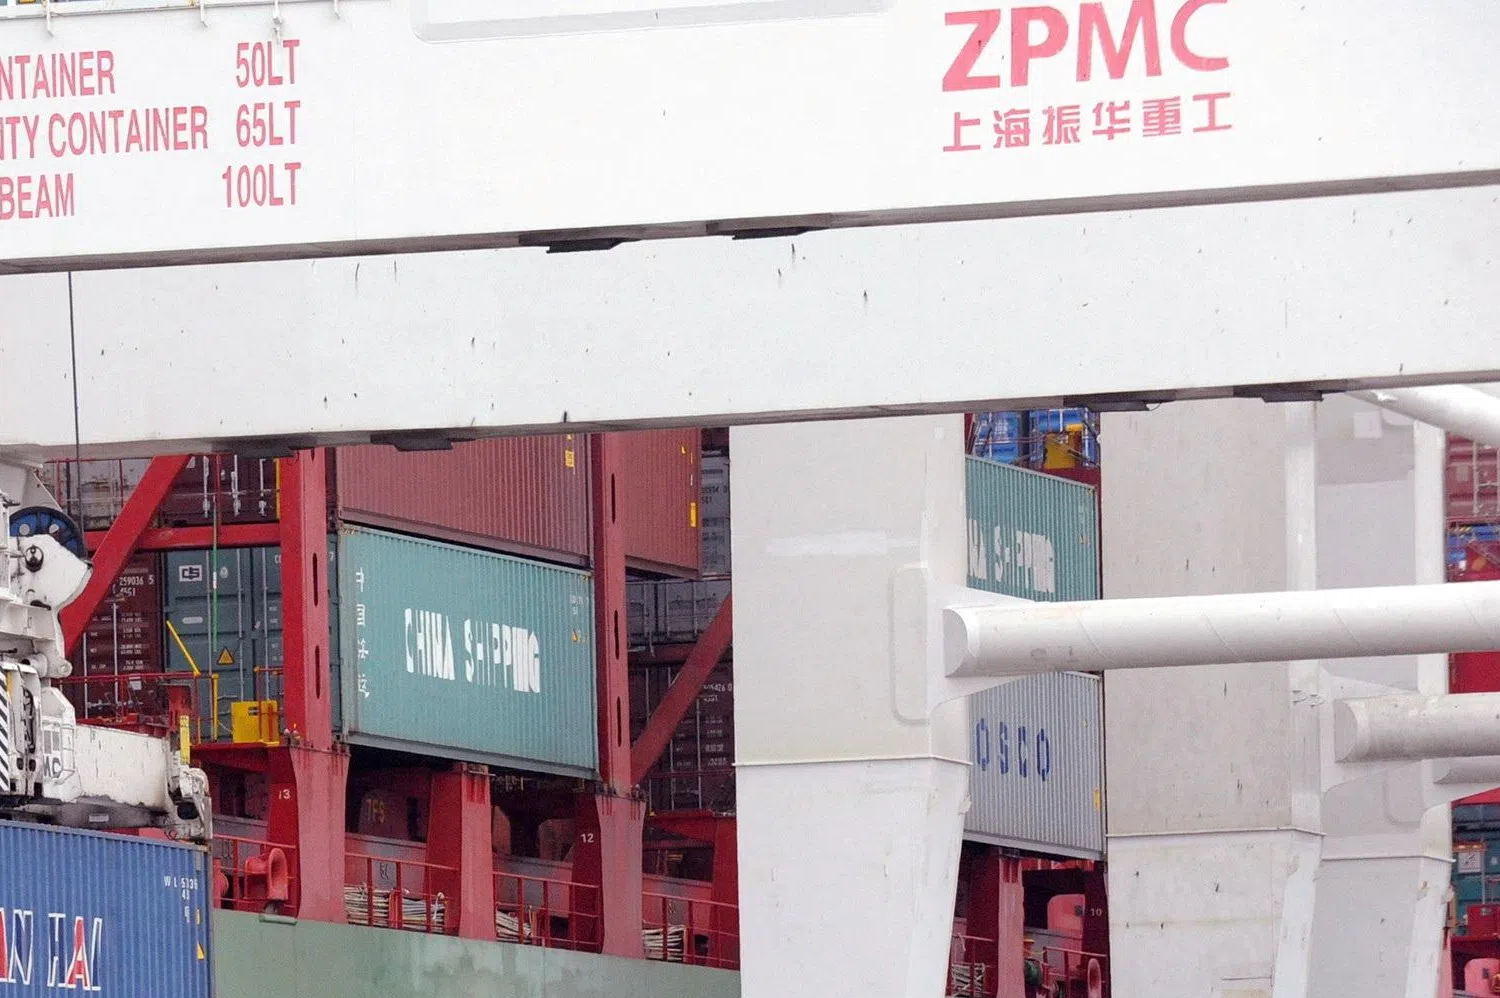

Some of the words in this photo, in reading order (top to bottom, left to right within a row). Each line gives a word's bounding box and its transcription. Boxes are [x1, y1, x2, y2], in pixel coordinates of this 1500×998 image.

[236, 39, 300, 88] 50LT
[942, 0, 1230, 92] ZPMC
[47, 106, 209, 158] CONTAINER
[236, 101, 301, 148] 65LT
[942, 92, 1232, 152] 上海振华重工
[222, 161, 301, 209] 100LT
[405, 608, 455, 680] CHINA
[464, 618, 540, 693] SHIPPING
[278, 789, 291, 799] 13
[581, 833, 594, 843] 12
[1090, 908, 1102, 917] 10
[48, 913, 102, 991] HAI
